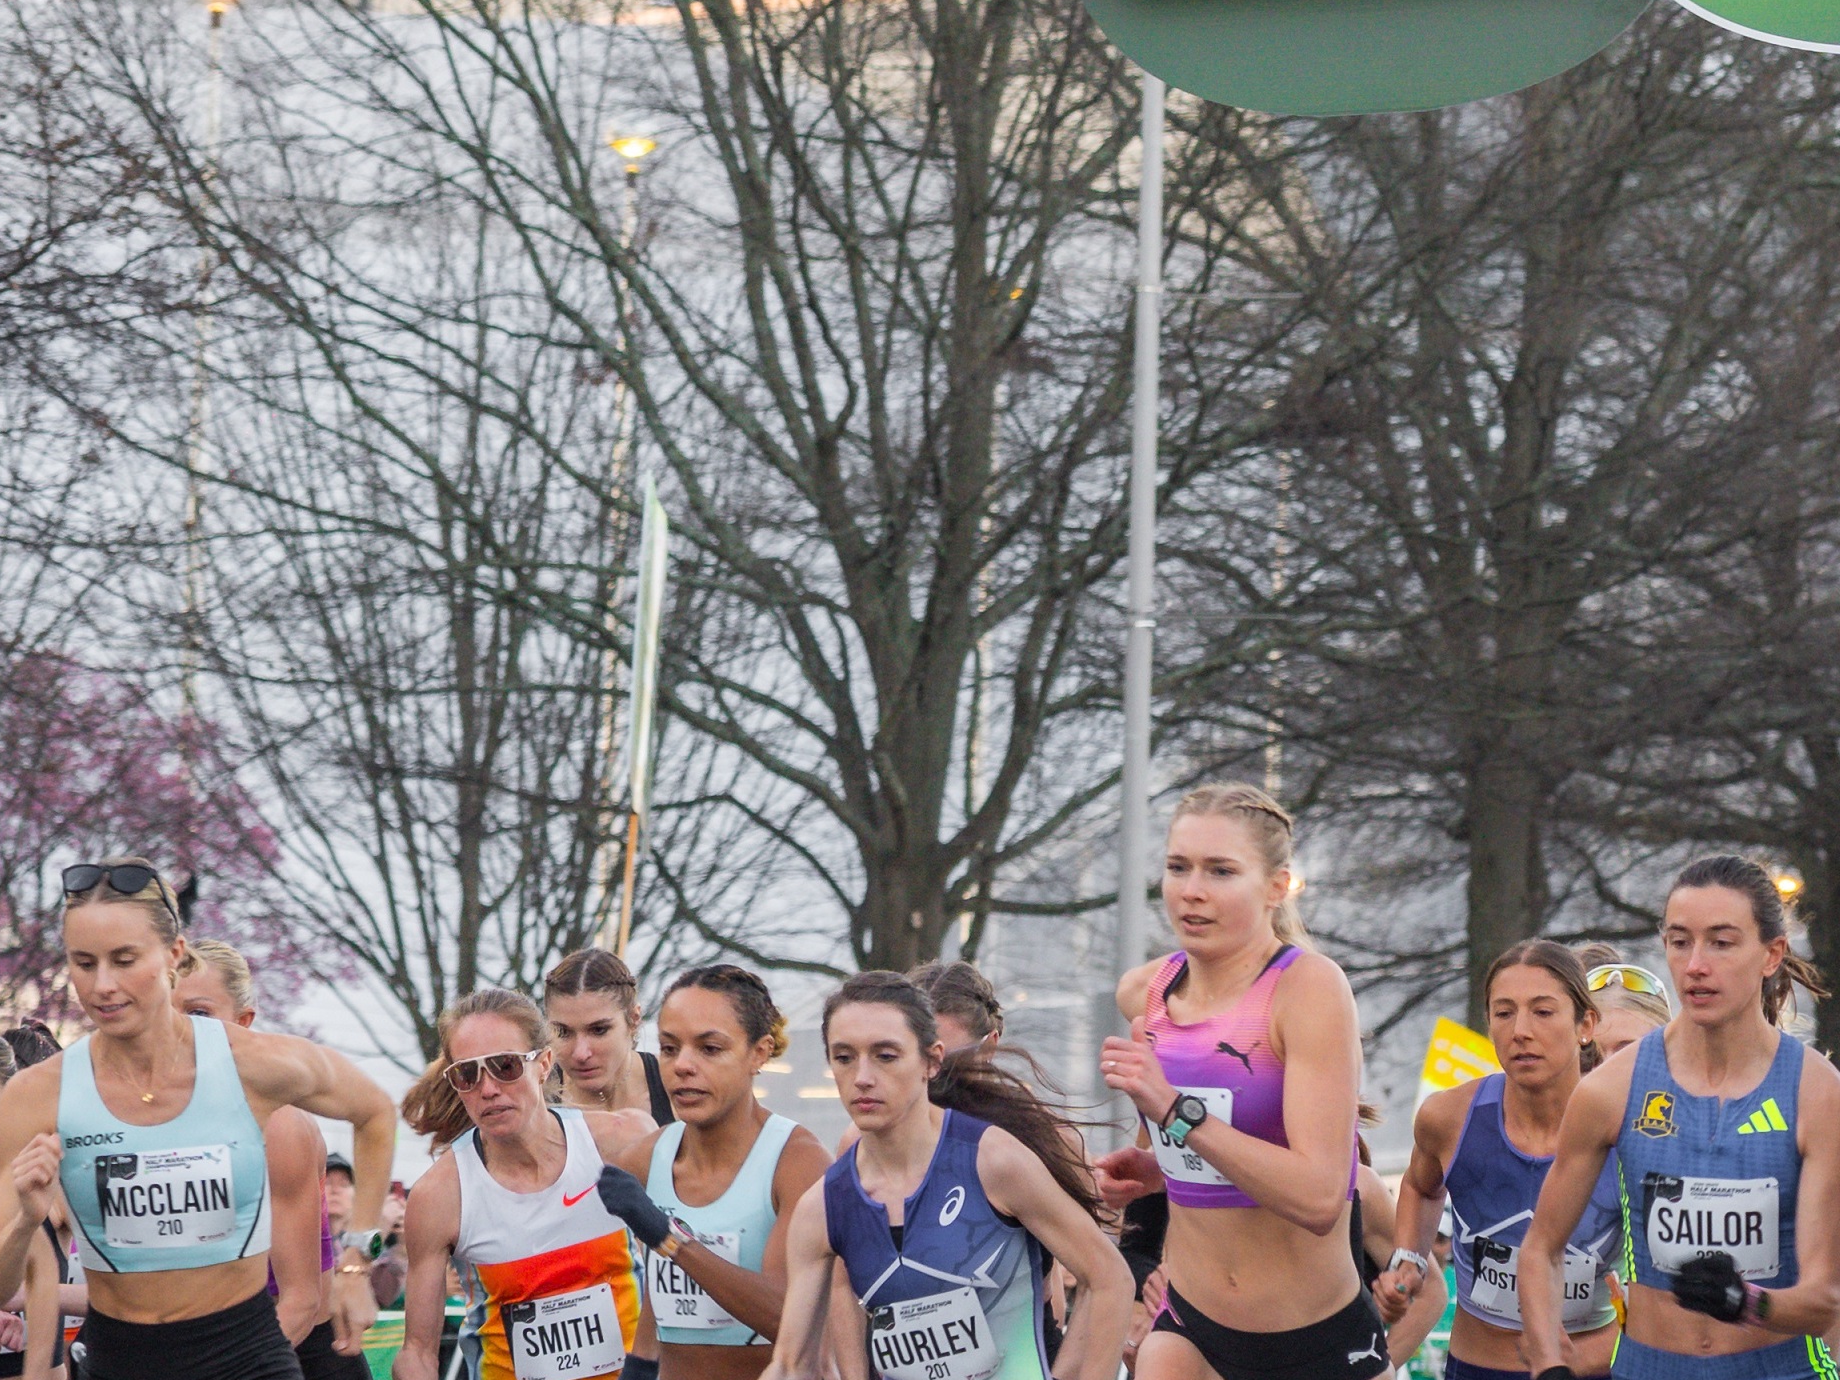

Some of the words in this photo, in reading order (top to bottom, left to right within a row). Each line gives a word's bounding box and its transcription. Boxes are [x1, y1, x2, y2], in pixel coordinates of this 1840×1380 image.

[65, 1131, 125, 1149] BROOKS
[1181, 1153, 1204, 1172] 189
[104, 1177, 230, 1218] MCCLAIN
[1710, 1186, 1752, 1195] MARATHON
[157, 1218, 184, 1236] 210
[1657, 1207, 1764, 1247] SAILOR
[558, 1295, 591, 1307] MARATHON
[675, 1298, 698, 1316] 202
[917, 1300, 952, 1312] MARATHON
[522, 1313, 605, 1358] SMITH
[873, 1315, 980, 1370] HURLEY
[556, 1352, 581, 1372] 224
[925, 1361, 952, 1380] 201
